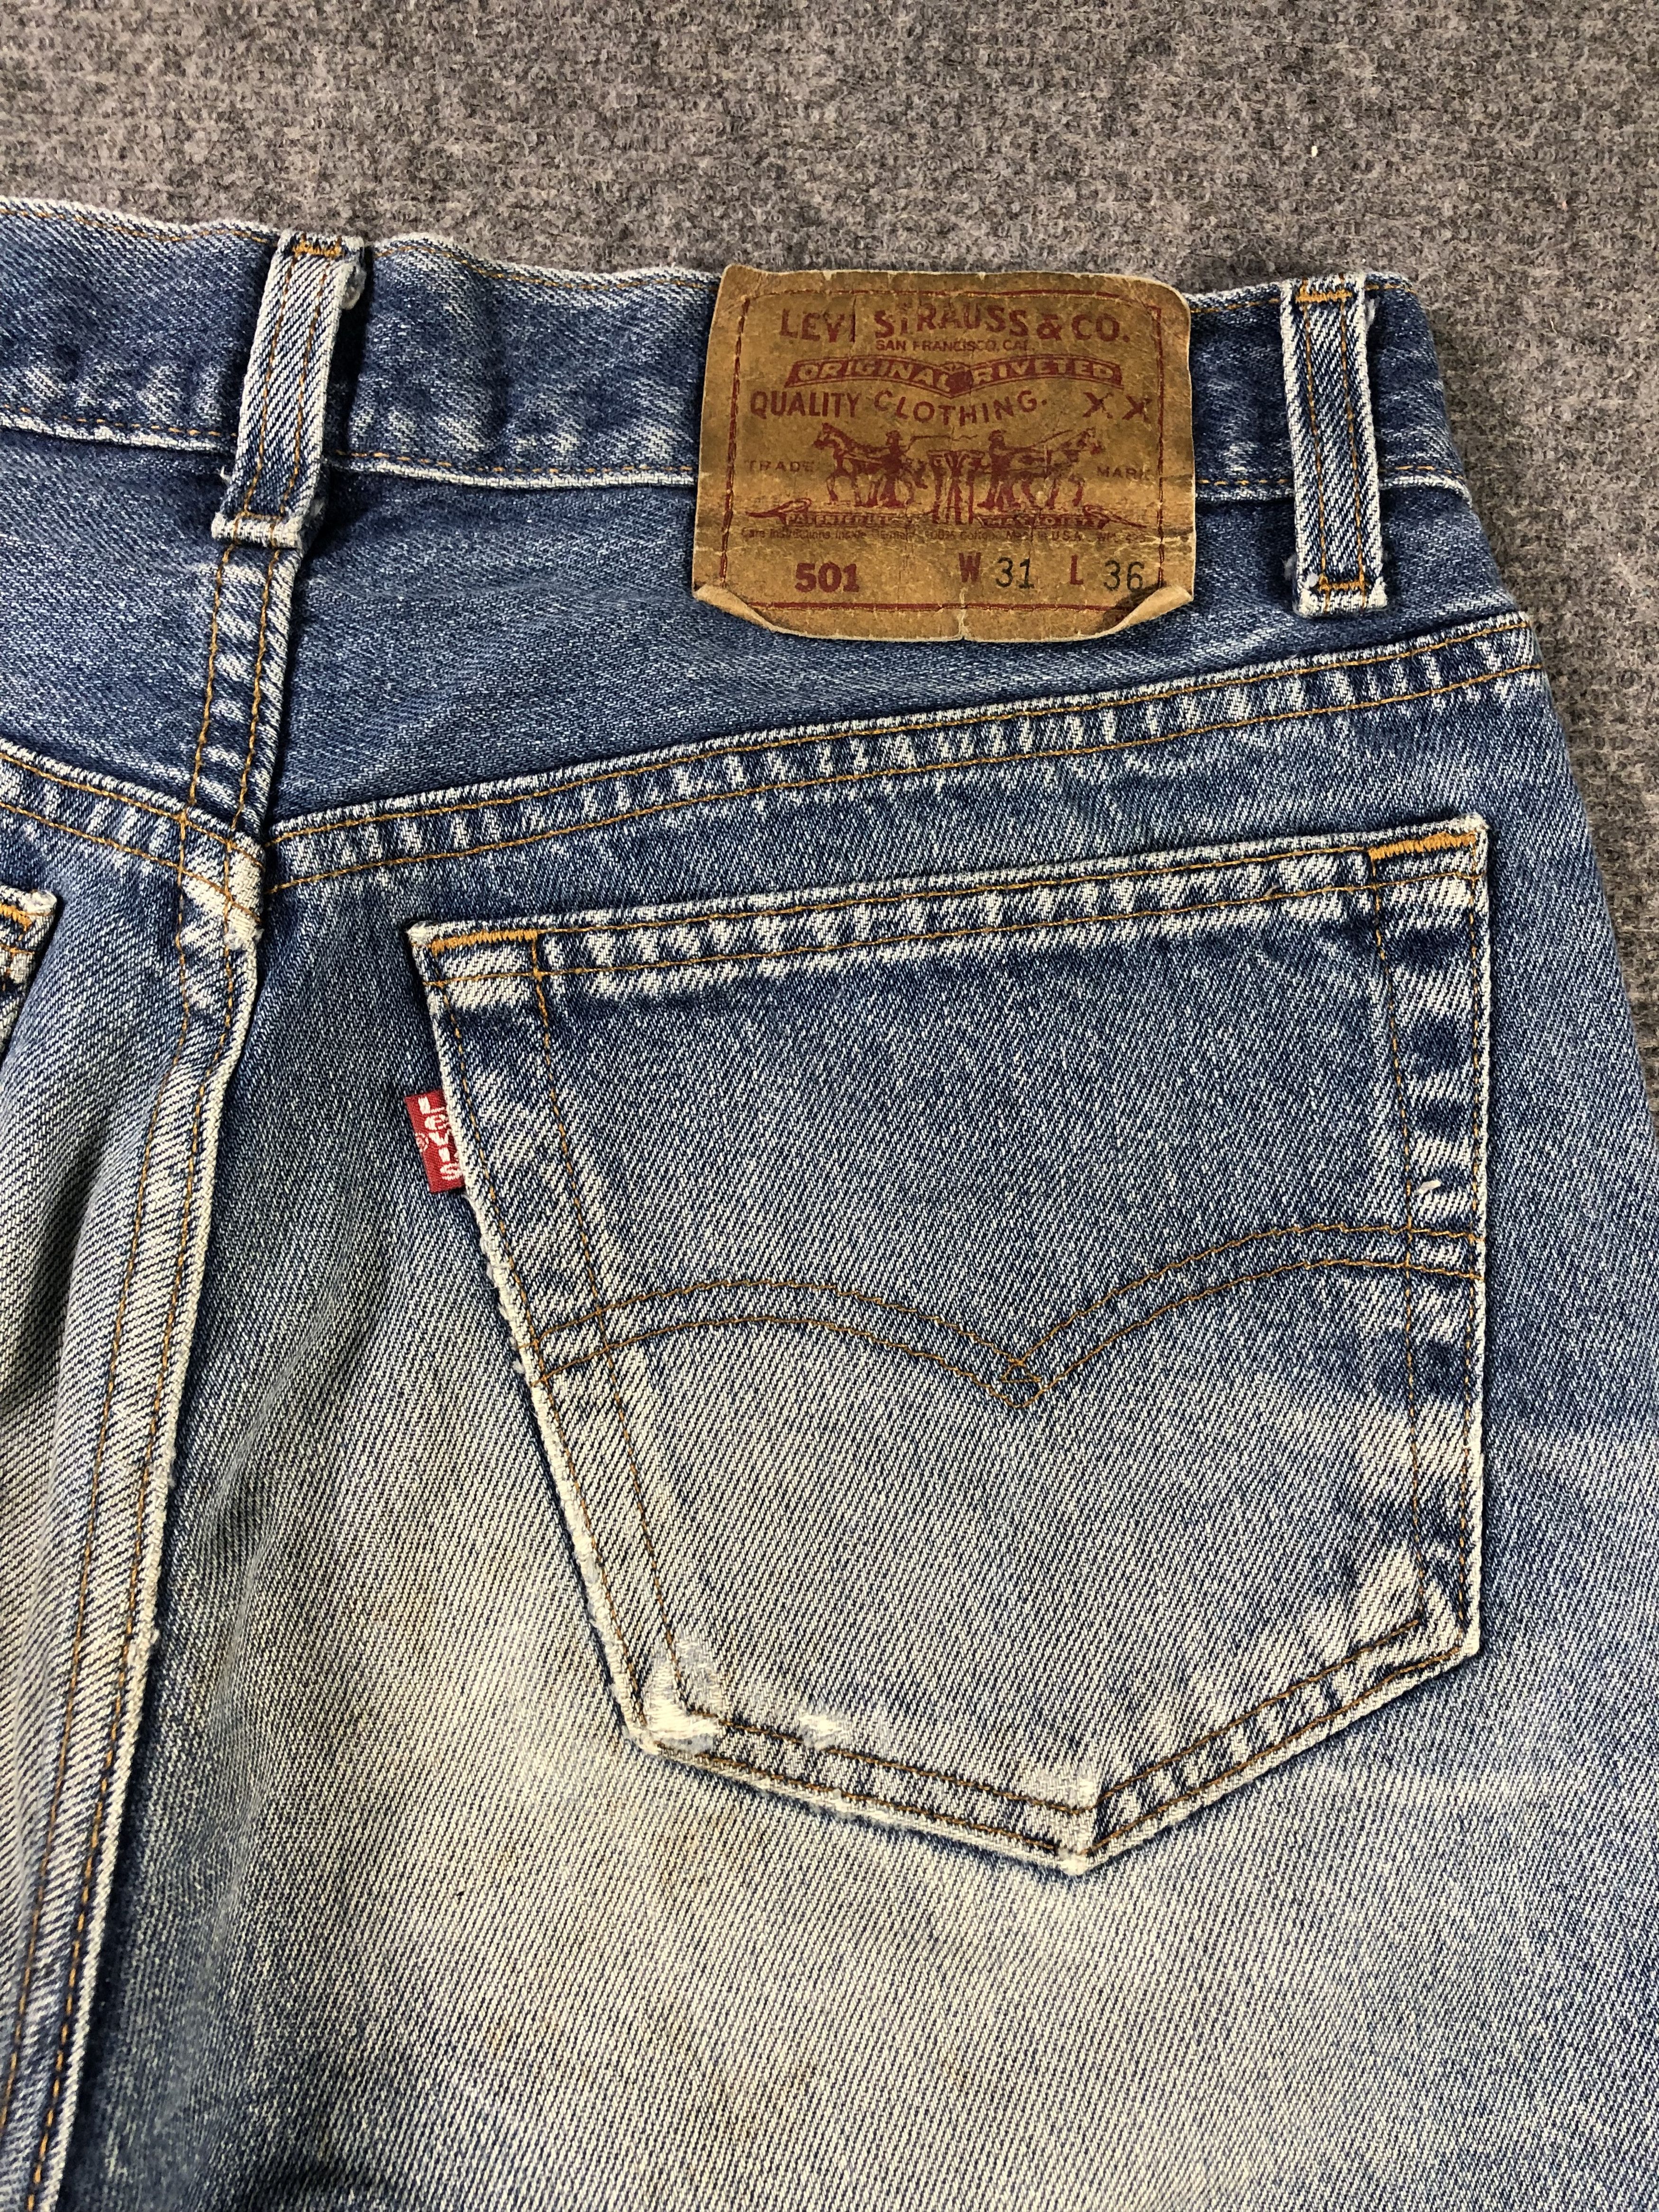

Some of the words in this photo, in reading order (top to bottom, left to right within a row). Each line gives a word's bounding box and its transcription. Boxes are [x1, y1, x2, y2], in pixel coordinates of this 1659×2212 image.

[780, 308, 855, 343] LEVI
[1036, 313, 1062, 341] &
[1071, 312, 1131, 342] CO.
[876, 339, 906, 351] SAN
[973, 356, 1114, 386] RIVETED
[750, 390, 861, 420] QUALITY
[743, 460, 815, 472] TRADE
[795, 562, 859, 592] 501
[958, 552, 981, 583] W
[996, 557, 1035, 589] 31
[1070, 555, 1084, 585] L
[1103, 560, 1144, 592] 36
